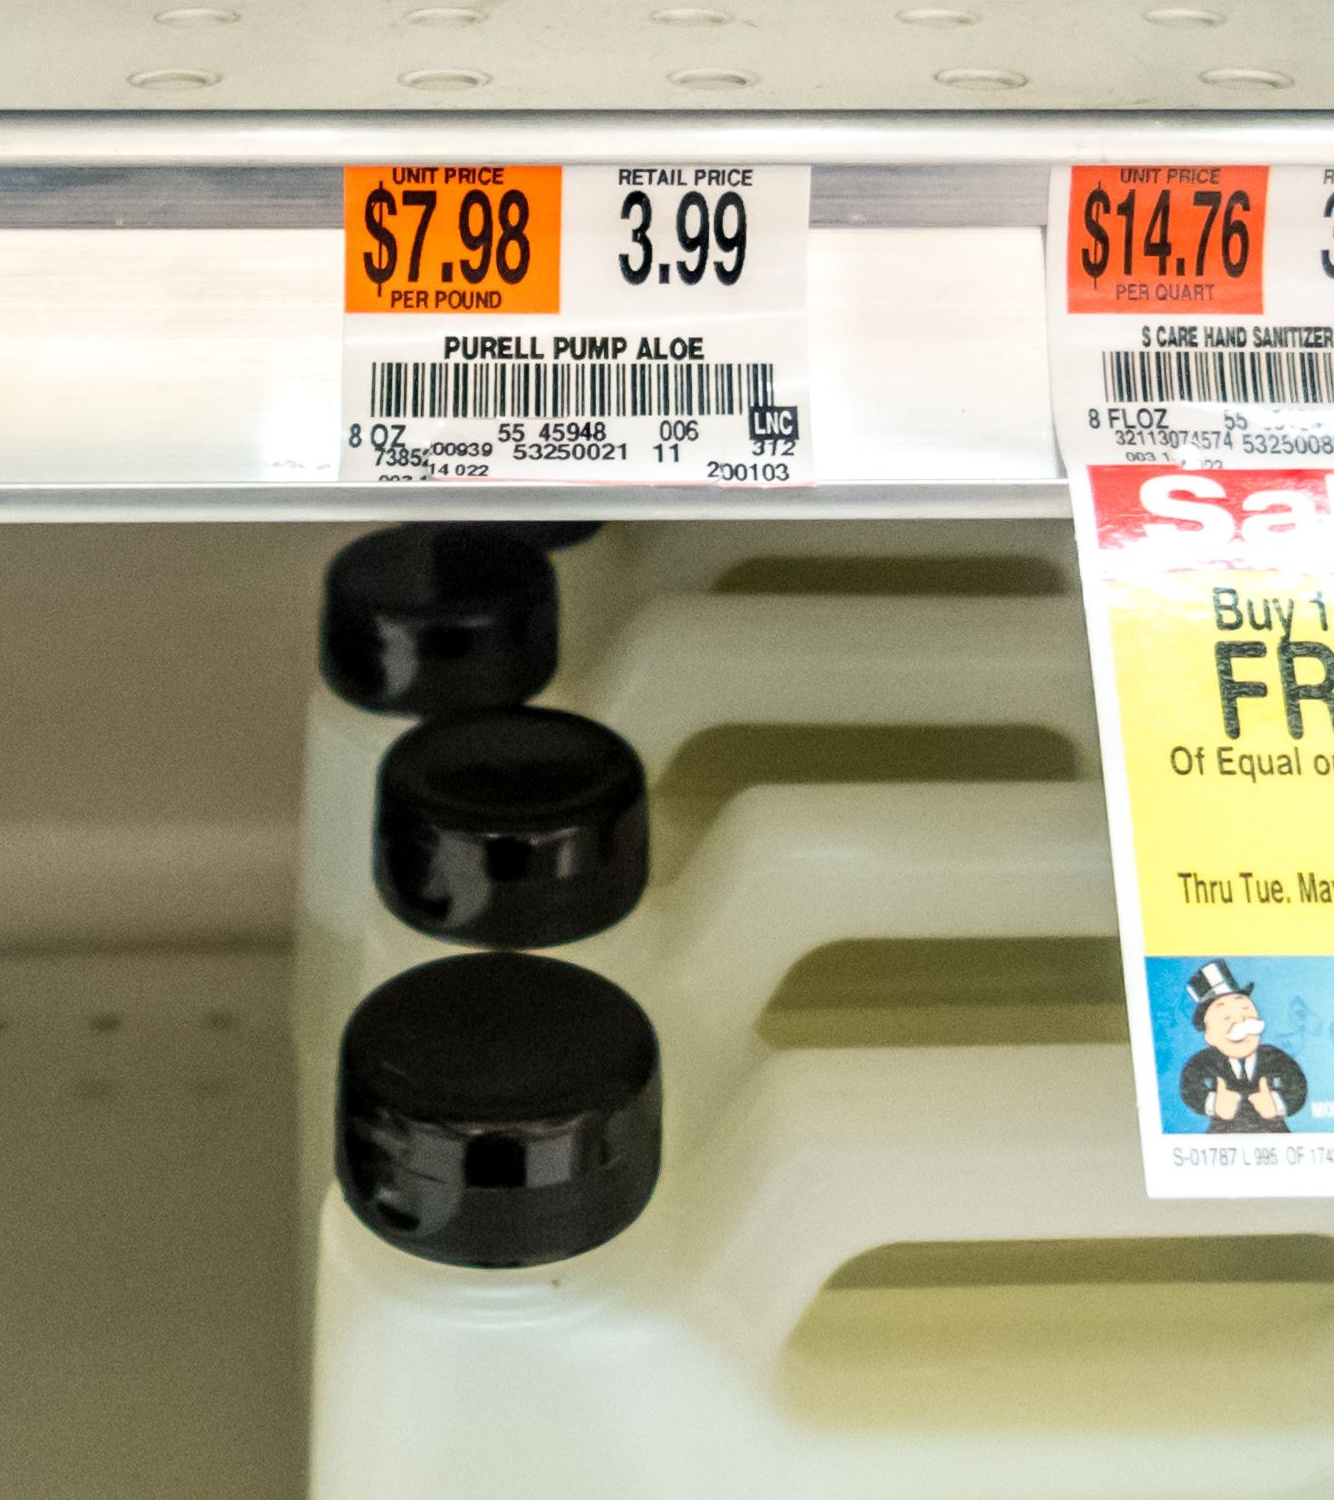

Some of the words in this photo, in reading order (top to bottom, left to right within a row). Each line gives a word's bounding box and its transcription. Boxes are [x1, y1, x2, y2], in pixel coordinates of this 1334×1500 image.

[392, 167, 439, 185] UNIT
[444, 167, 505, 186] PRICE
[618, 168, 688, 186] RETAIL
[694, 168, 754, 187] PRICE
[1119, 168, 1161, 184] UNIT
[1166, 168, 1221, 185] PRICE
[363, 181, 530, 297] $7.98
[618, 190, 747, 286] 3.99
[1081, 180, 1252, 290] $14.76
[390, 291, 429, 309] PER
[435, 290, 502, 309] POUND
[1115, 284, 1149, 301] PER
[1154, 284, 1215, 302] QUART
[443, 336, 545, 360] PURELL
[552, 336, 628, 360] PUMP
[636, 336, 705, 360] ALOE
[1142, 327, 1152, 348] S
[1156, 326, 1198, 348] CARE
[1204, 326, 1247, 348] HAND
[1253, 326, 1334, 349] SANITIZER
[348, 423, 362, 448] 8
[370, 424, 407, 450] OZ
[498, 423, 525, 442] 55
[539, 421, 607, 442] 45948
[659, 420, 699, 441] 006
[751, 407, 798, 439] LNC
[1088, 408, 1101, 429] 8
[1107, 407, 1169, 430] FLOZ
[1223, 409, 1249, 430] 55
[512, 443, 627, 461] 53250021
[653, 443, 680, 463] 11
[751, 440, 796, 456] 312
[455, 464, 489, 477] 022
[706, 461, 790, 481] 200103
[1212, 587, 1296, 641] Buy
[1170, 746, 1207, 776] Of
[1217, 746, 1303, 784] Equal
[1177, 872, 1233, 905] Thru
[1239, 872, 1292, 905] Tue.
